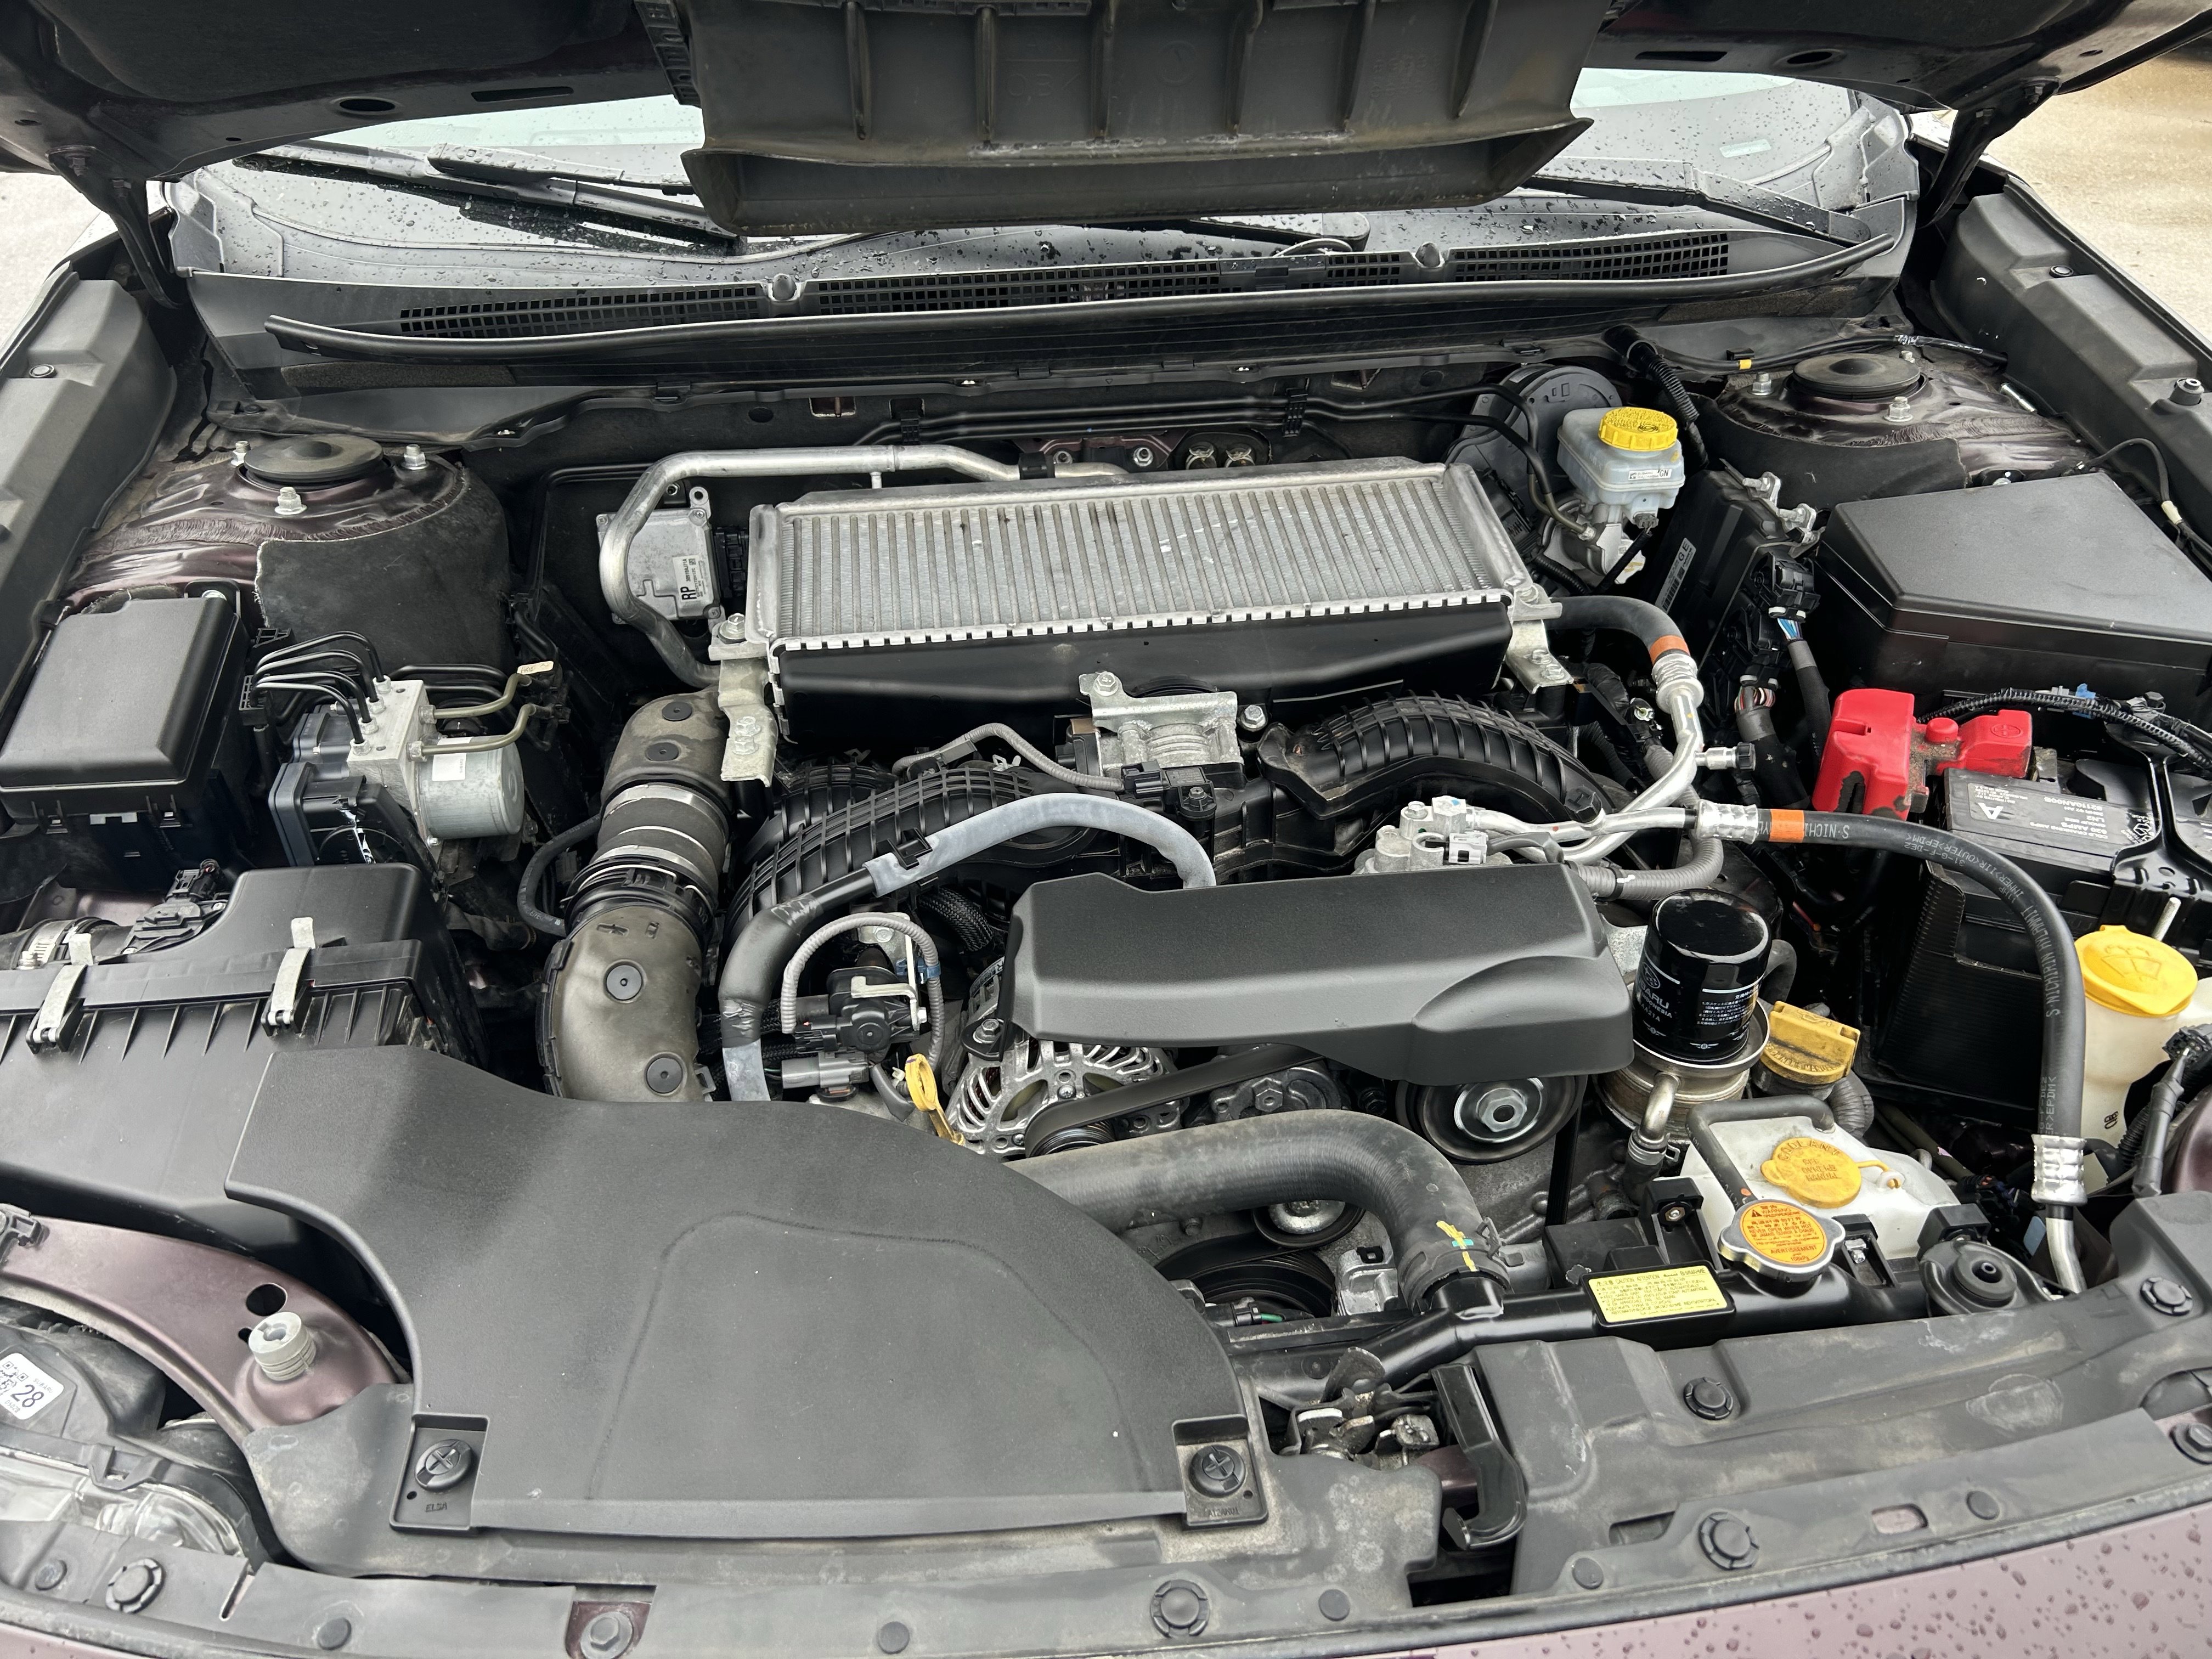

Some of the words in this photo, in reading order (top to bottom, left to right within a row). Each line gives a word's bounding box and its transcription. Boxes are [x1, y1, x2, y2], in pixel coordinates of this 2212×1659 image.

[680, 586, 697, 600] RP
[2051, 825, 2087, 836] CRANKING
[2061, 822, 2089, 831] AMPS
[1778, 1140, 1840, 1161] COOLANT
[1770, 1245, 1817, 1254] AVERTISSEMENT
[10, 1384, 44, 1408] 28
